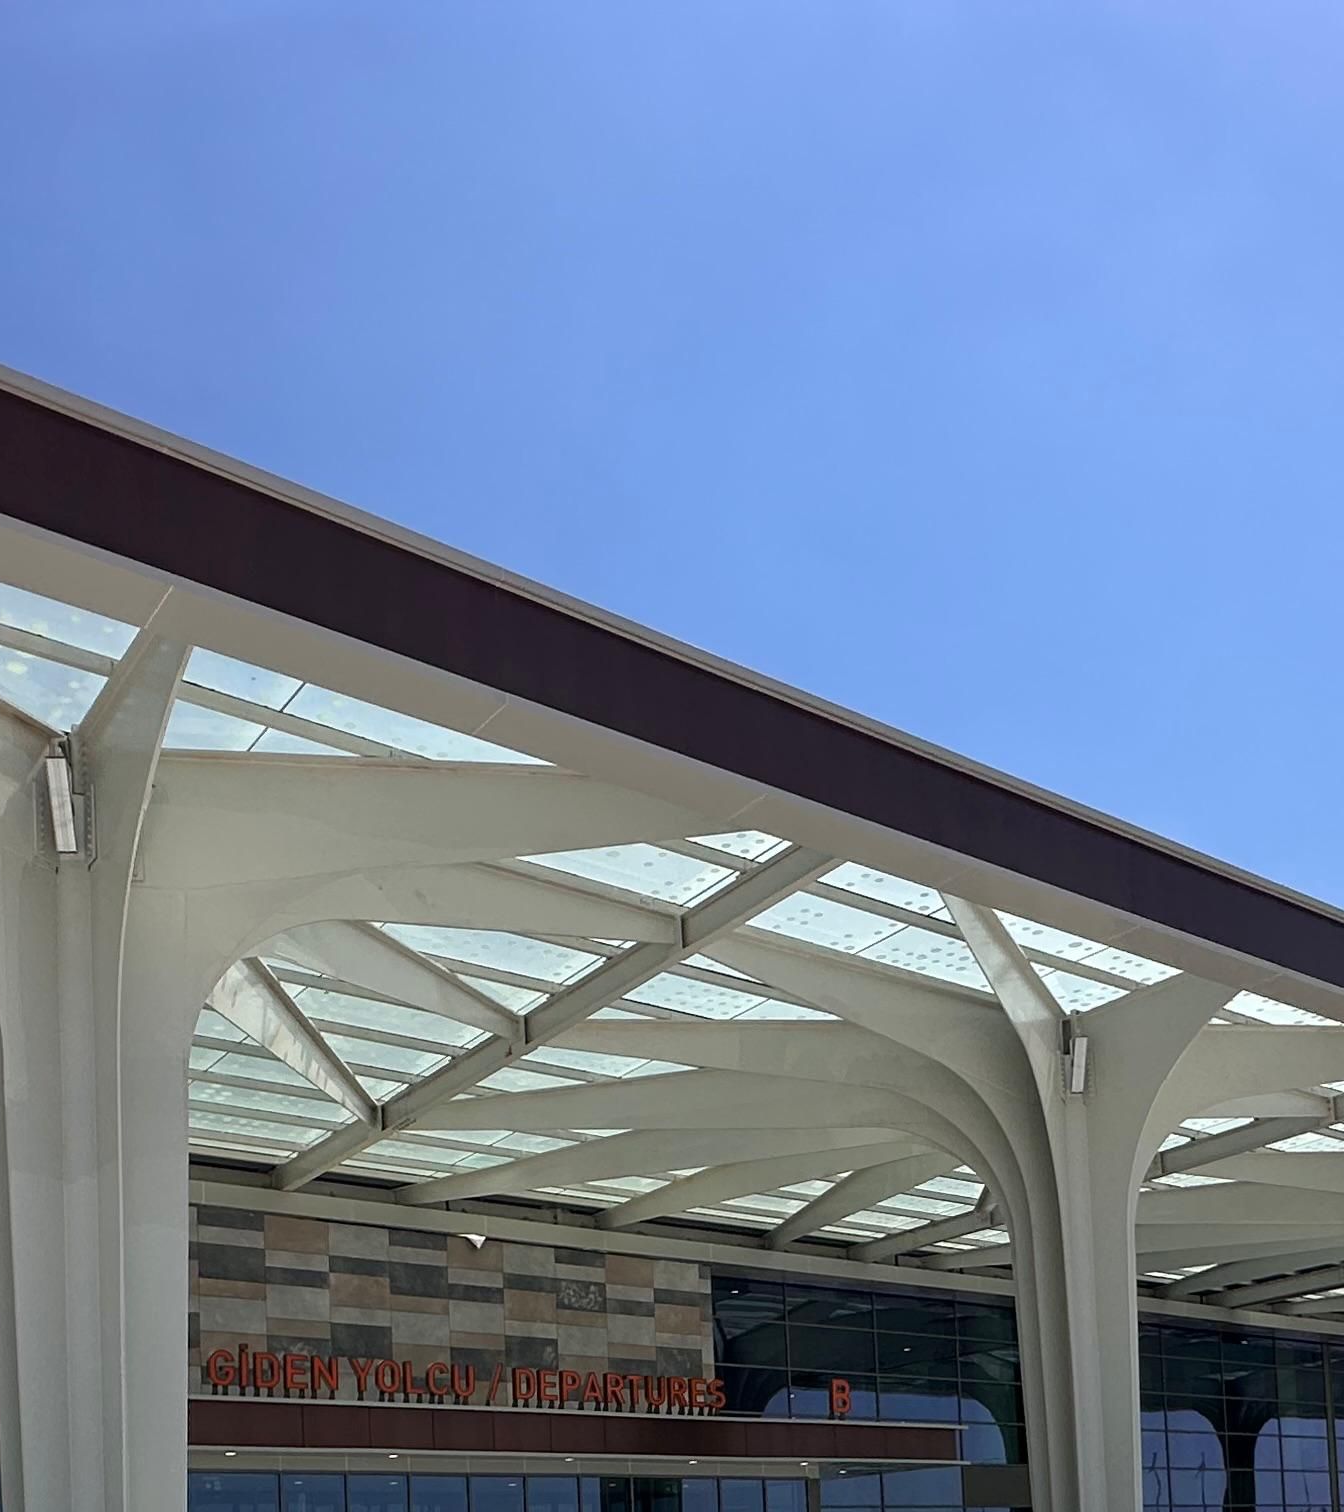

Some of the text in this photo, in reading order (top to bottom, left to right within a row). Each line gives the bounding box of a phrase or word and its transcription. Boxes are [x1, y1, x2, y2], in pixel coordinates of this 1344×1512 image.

[207, 1343, 339, 1391] GİDEN
[349, 1357, 476, 1397] YOLCU
[512, 1367, 726, 1409] DEPARTURES
[829, 1377, 851, 1414] B
